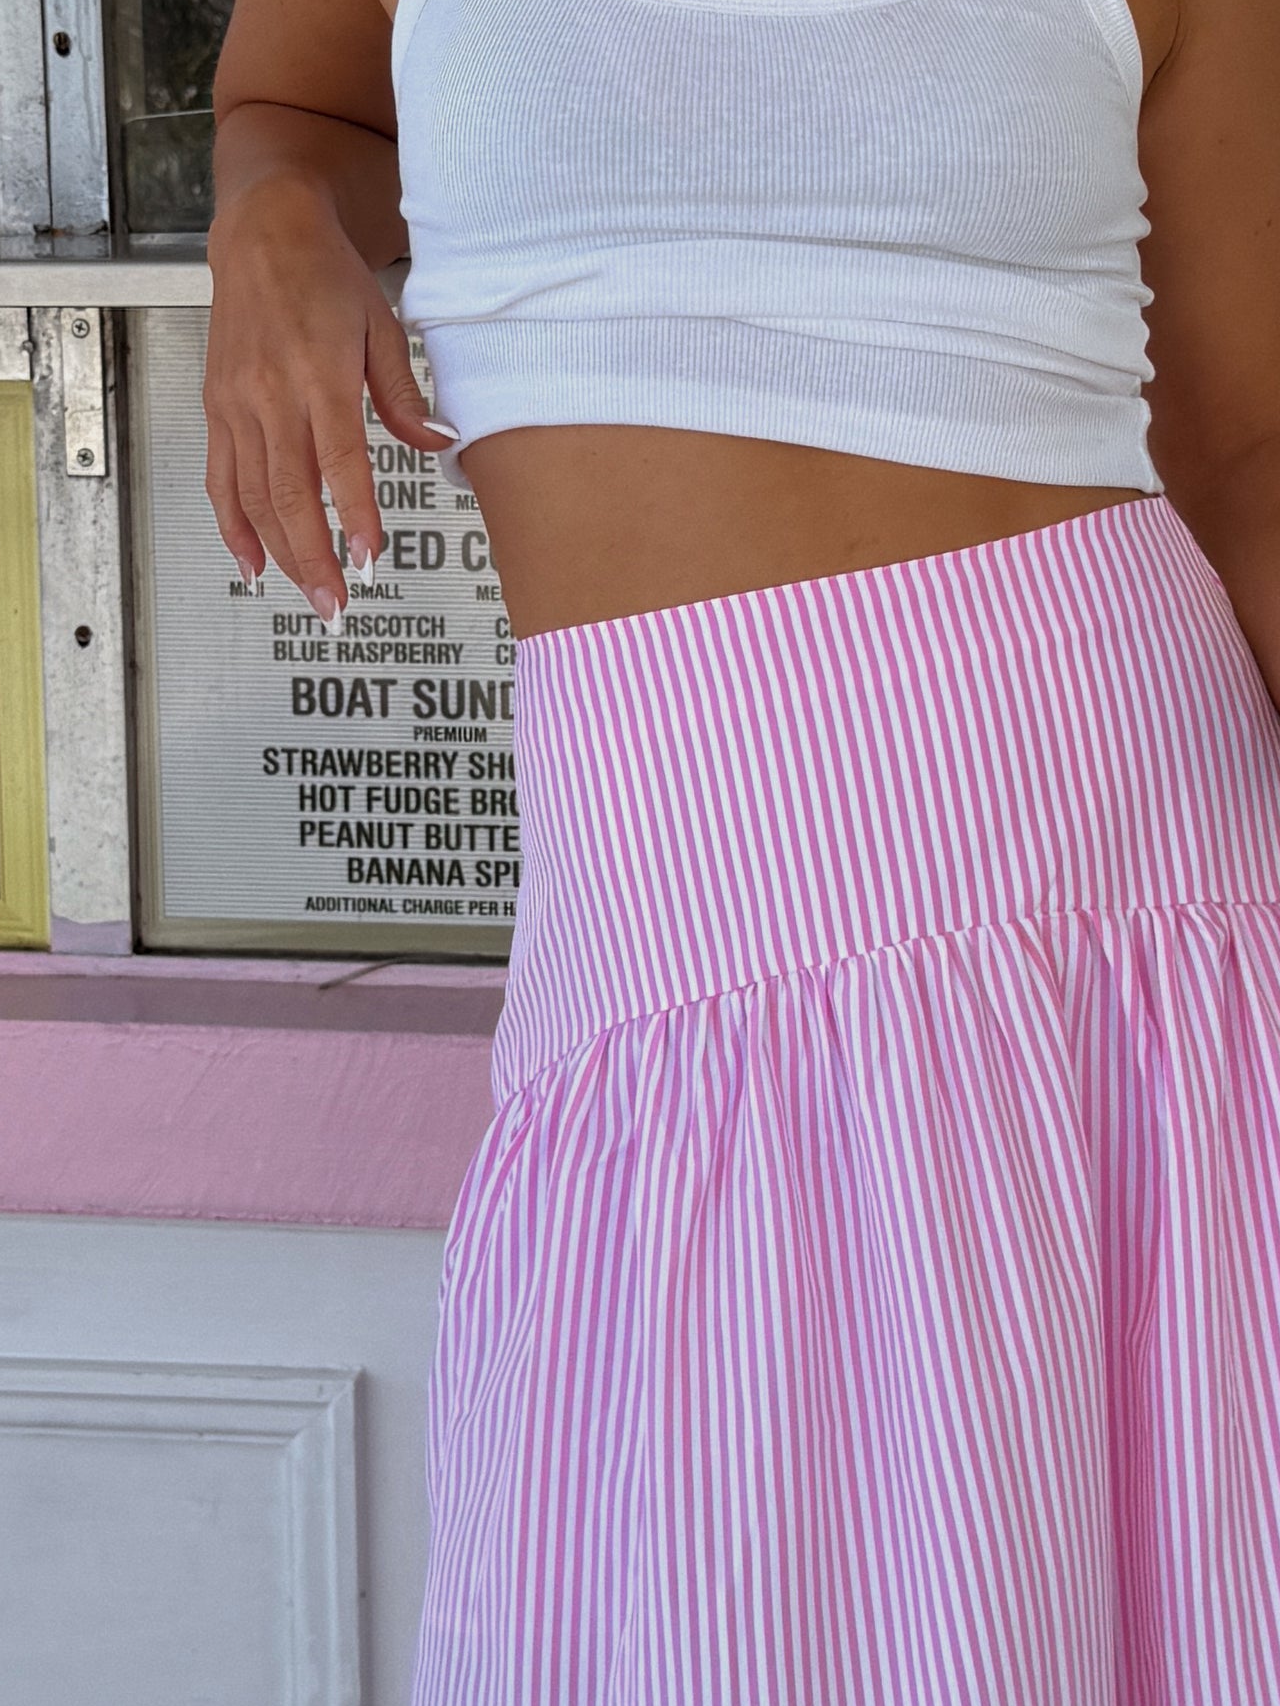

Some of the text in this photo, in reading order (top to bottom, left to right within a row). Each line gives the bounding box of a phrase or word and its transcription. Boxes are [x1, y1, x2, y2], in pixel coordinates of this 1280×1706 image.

[350, 584, 404, 601] SMALL
[273, 641, 464, 665] BLUE RASPBERRY
[291, 676, 398, 718] BOAT
[413, 726, 487, 743] PREMIUM
[263, 748, 459, 779] STRAWBERRY
[299, 784, 356, 812] HOT
[367, 786, 459, 815] FUDGE
[299, 820, 414, 849] PEANUT
[347, 857, 465, 886] BANANA
[305, 896, 499, 916] ADDITIONAL CHARGE PER
